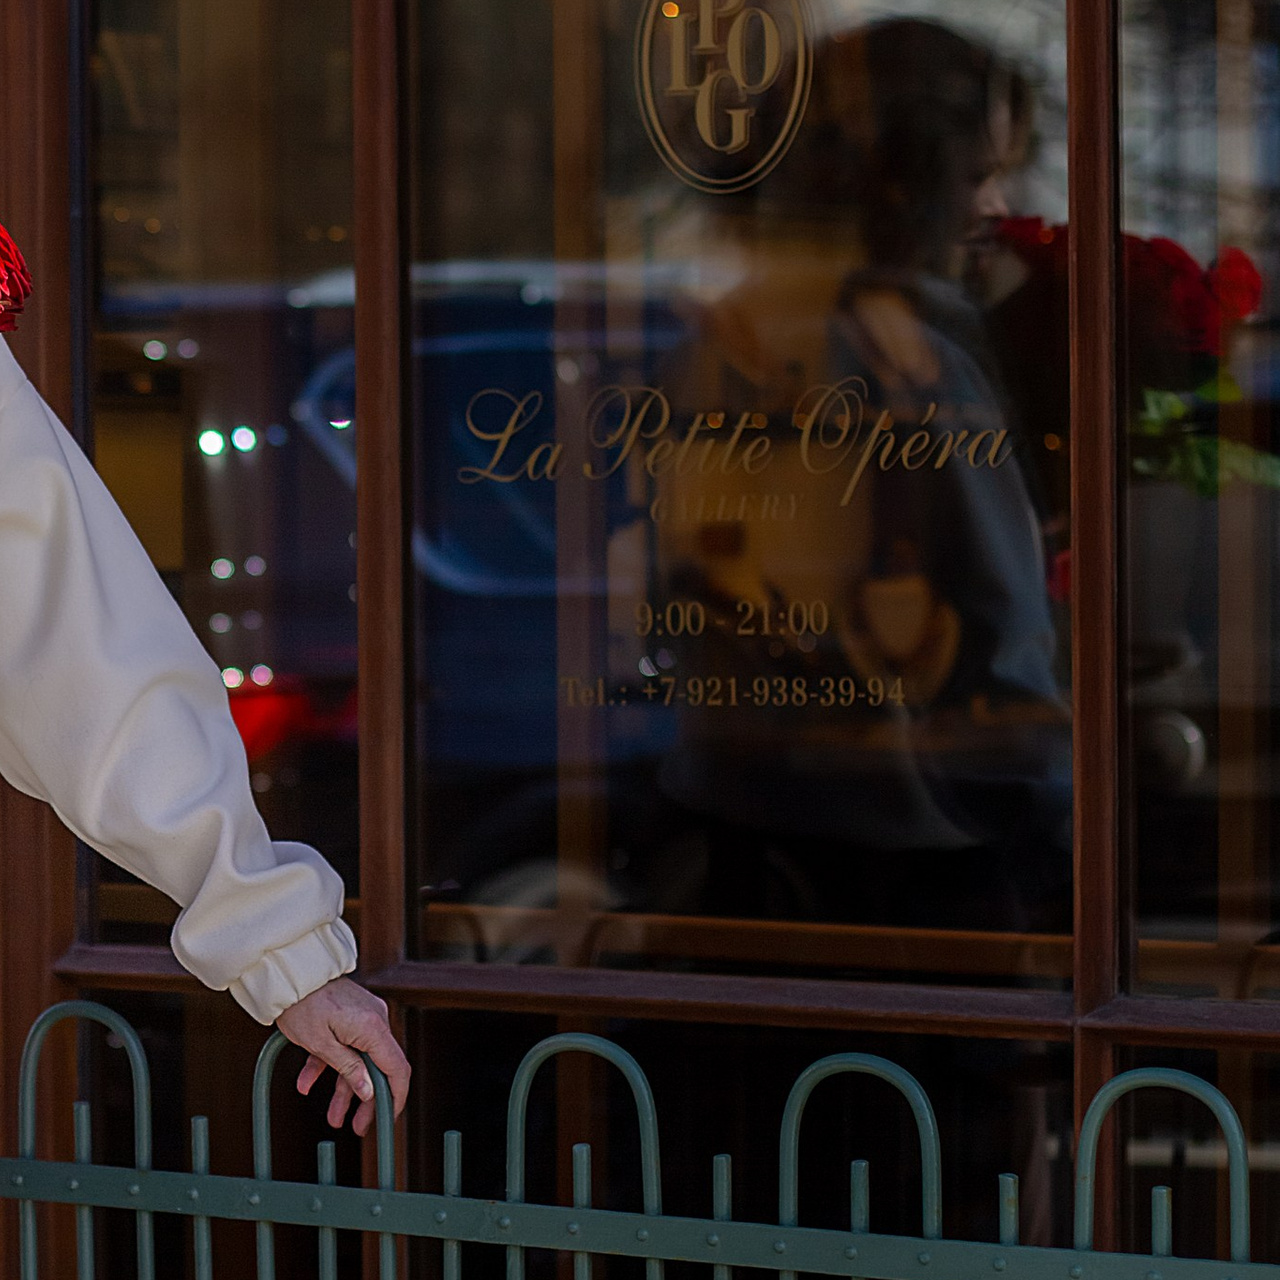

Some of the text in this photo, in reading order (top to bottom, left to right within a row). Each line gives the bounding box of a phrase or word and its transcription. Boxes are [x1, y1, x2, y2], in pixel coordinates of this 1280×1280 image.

[457, 375, 1014, 507] La Petite Opéra
[634, 601, 707, 637] 9:00
[736, 601, 829, 637] 21:00
[560, 676, 906, 707] Tel.: +7-921-938-39-94
